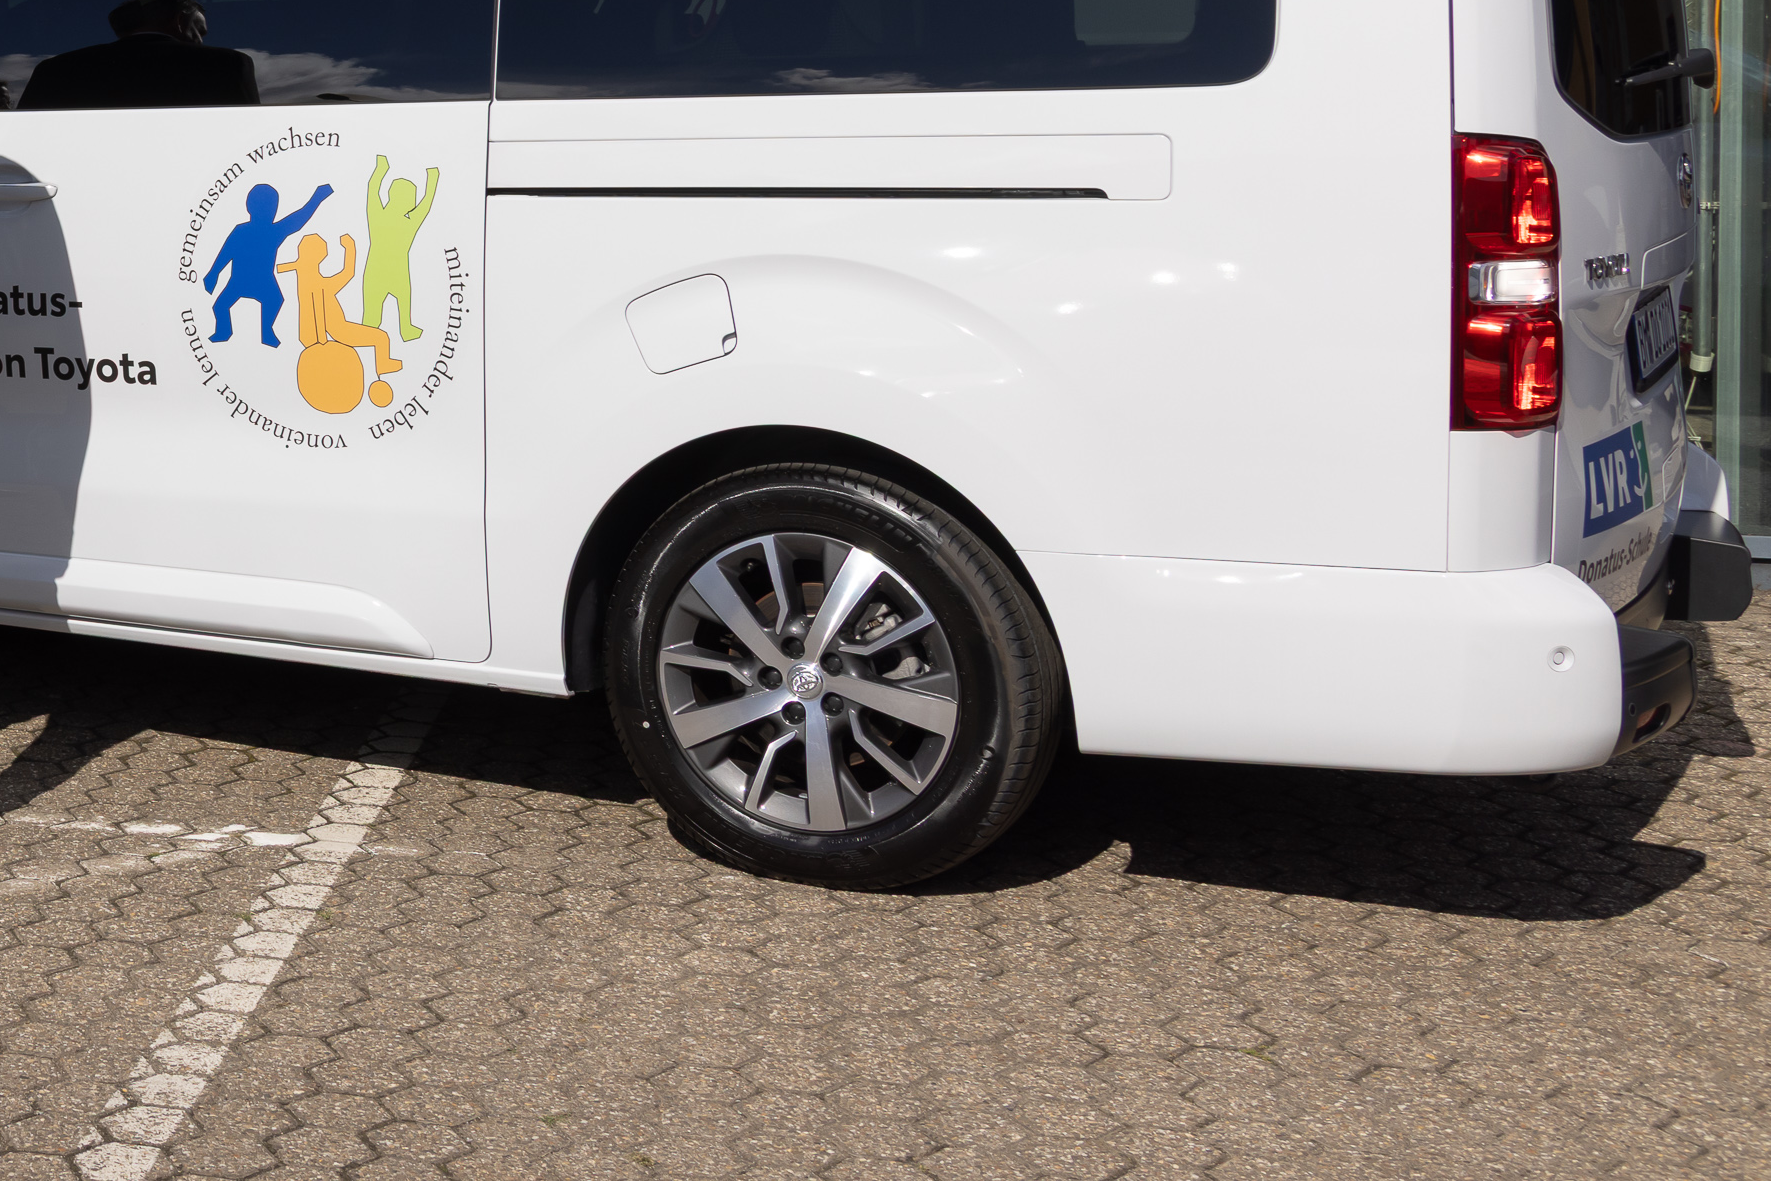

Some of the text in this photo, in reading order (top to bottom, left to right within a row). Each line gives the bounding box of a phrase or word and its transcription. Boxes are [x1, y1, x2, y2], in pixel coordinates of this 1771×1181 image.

[179, 126, 470, 449] miteinander leben voneinander lernen gemeinsam wachsen
[34, 346, 158, 391] Toyota
[1589, 449, 1632, 520] LVR
[1578, 527, 1653, 585] Donatus-Schule
